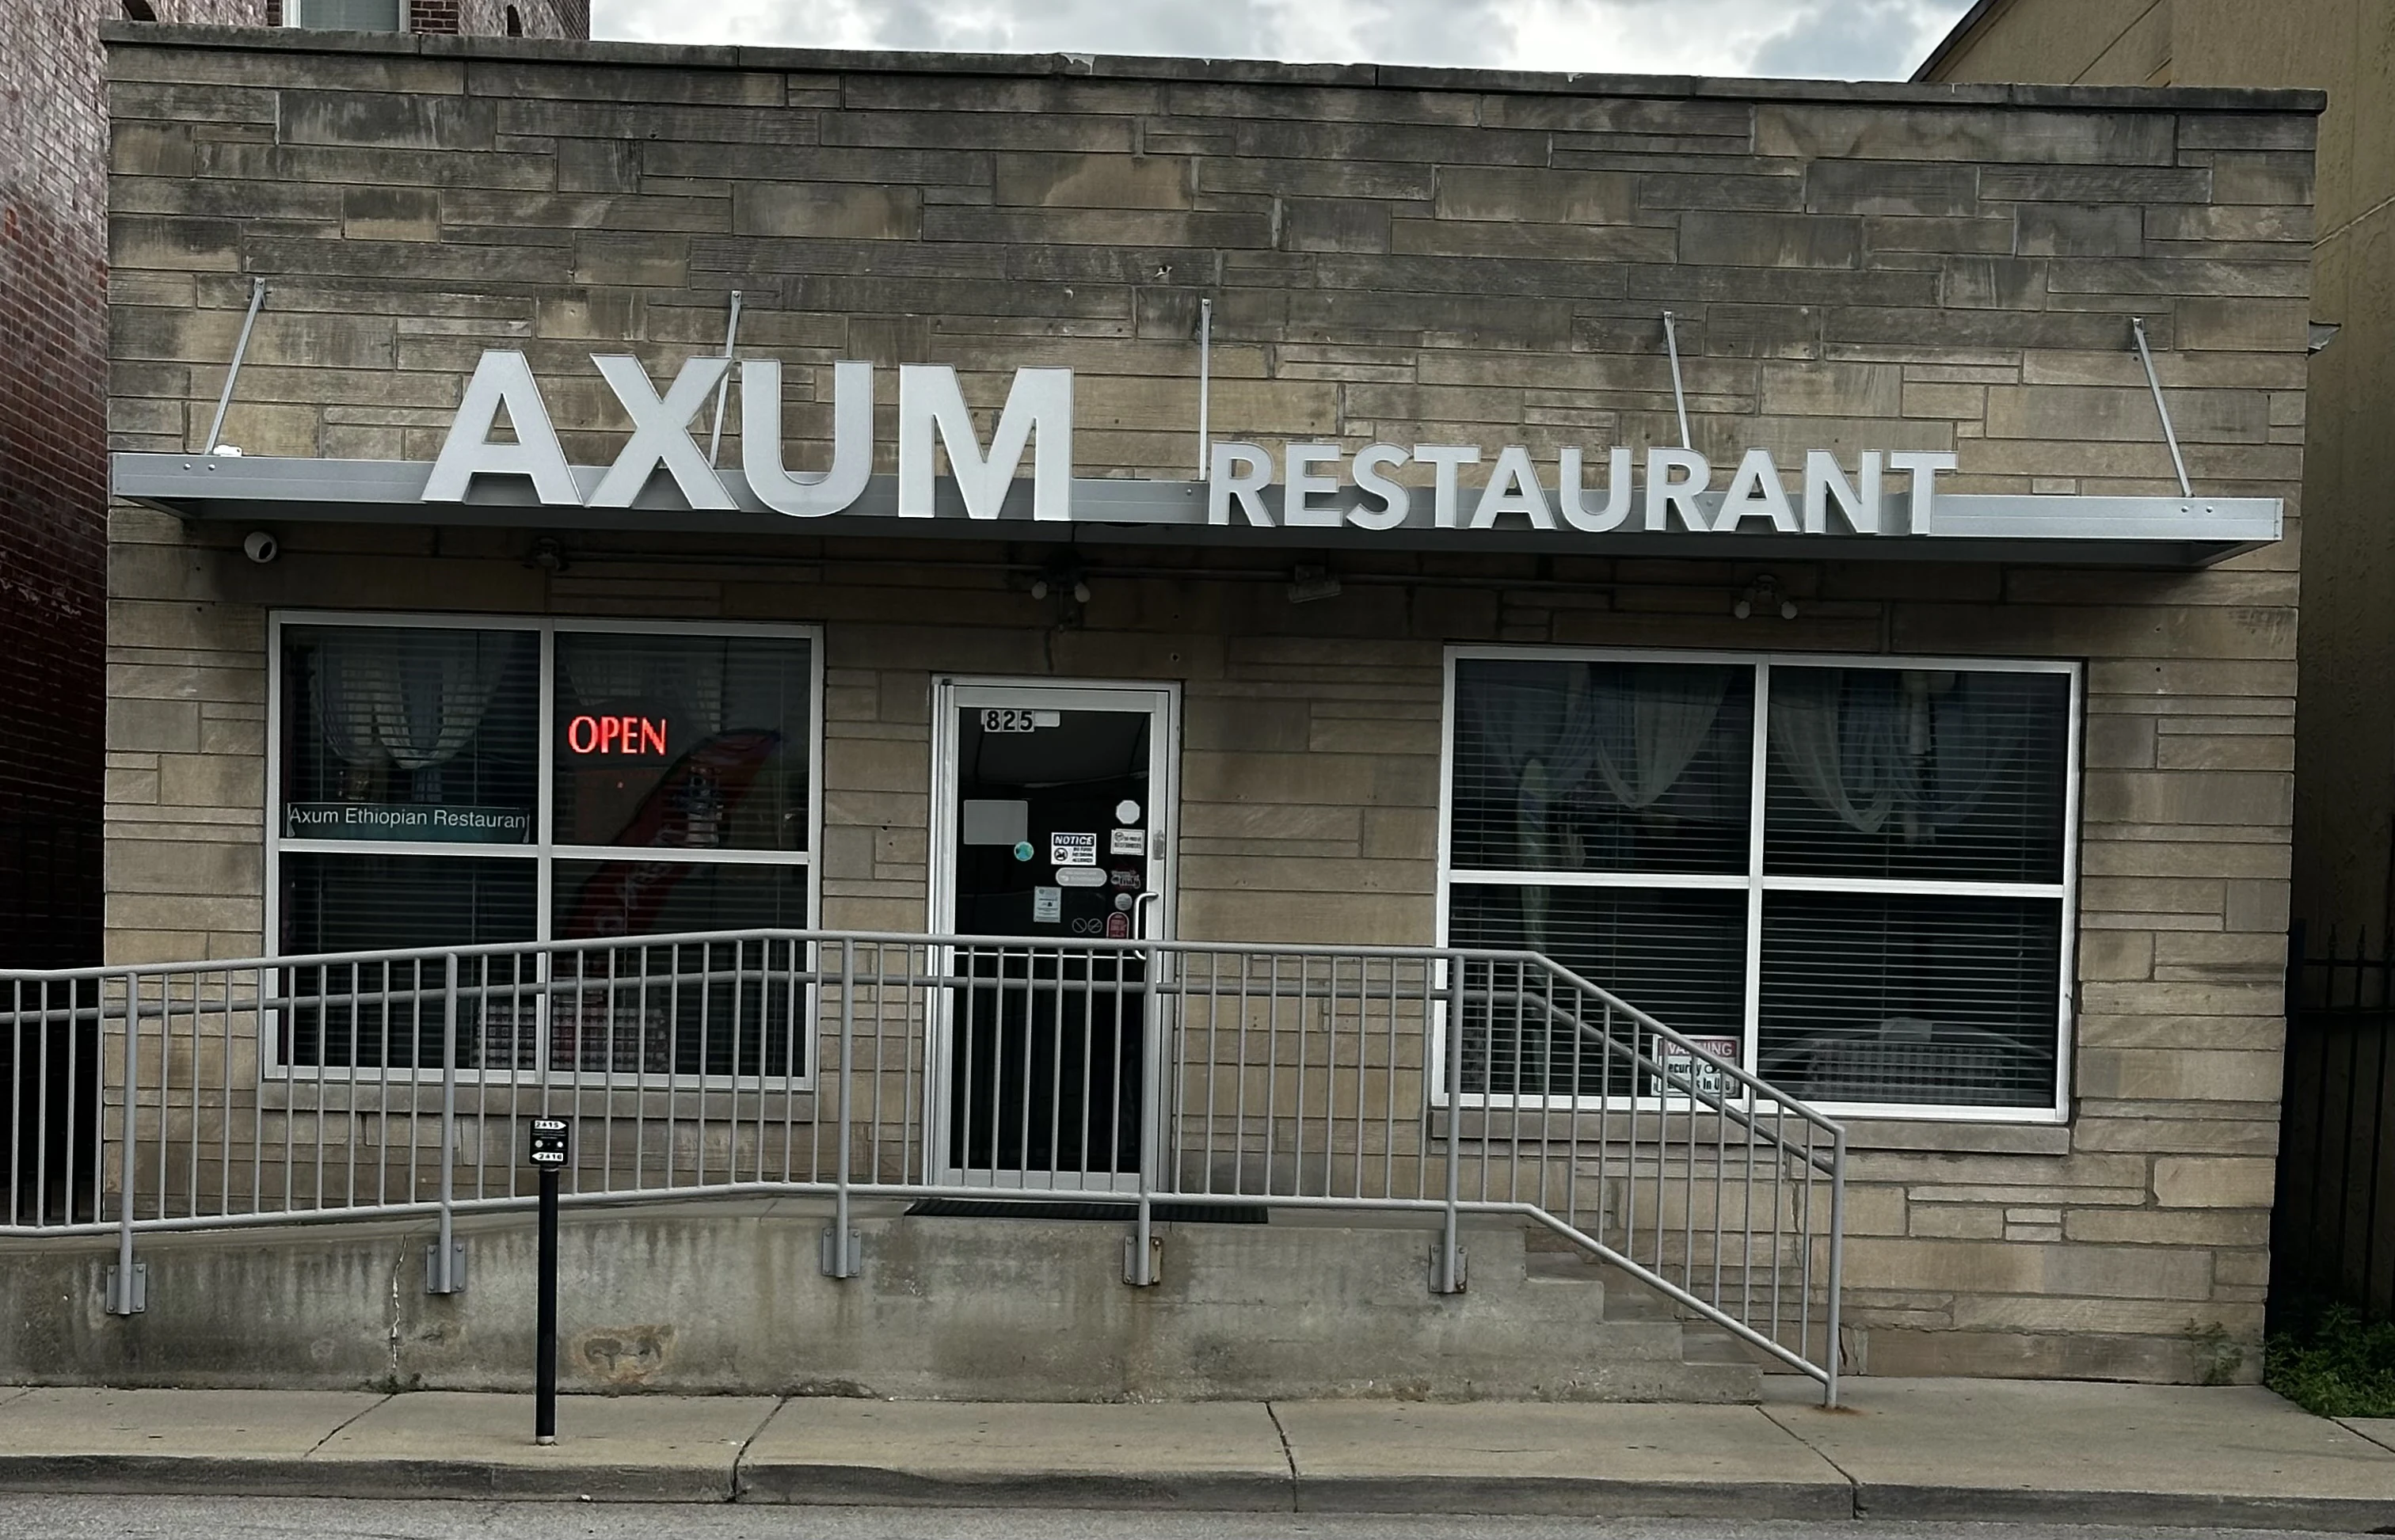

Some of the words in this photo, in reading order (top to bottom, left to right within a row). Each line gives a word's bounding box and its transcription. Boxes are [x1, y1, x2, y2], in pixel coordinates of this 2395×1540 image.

[421, 348, 1074, 522] AXUM
[1208, 440, 1957, 536] RESTAURANT
[568, 715, 667, 755] OPEN
[987, 710, 1033, 731] 825
[289, 807, 339, 823] Axum
[345, 807, 427, 828] Ethiopian
[1055, 835, 1093, 845] NOTICE
